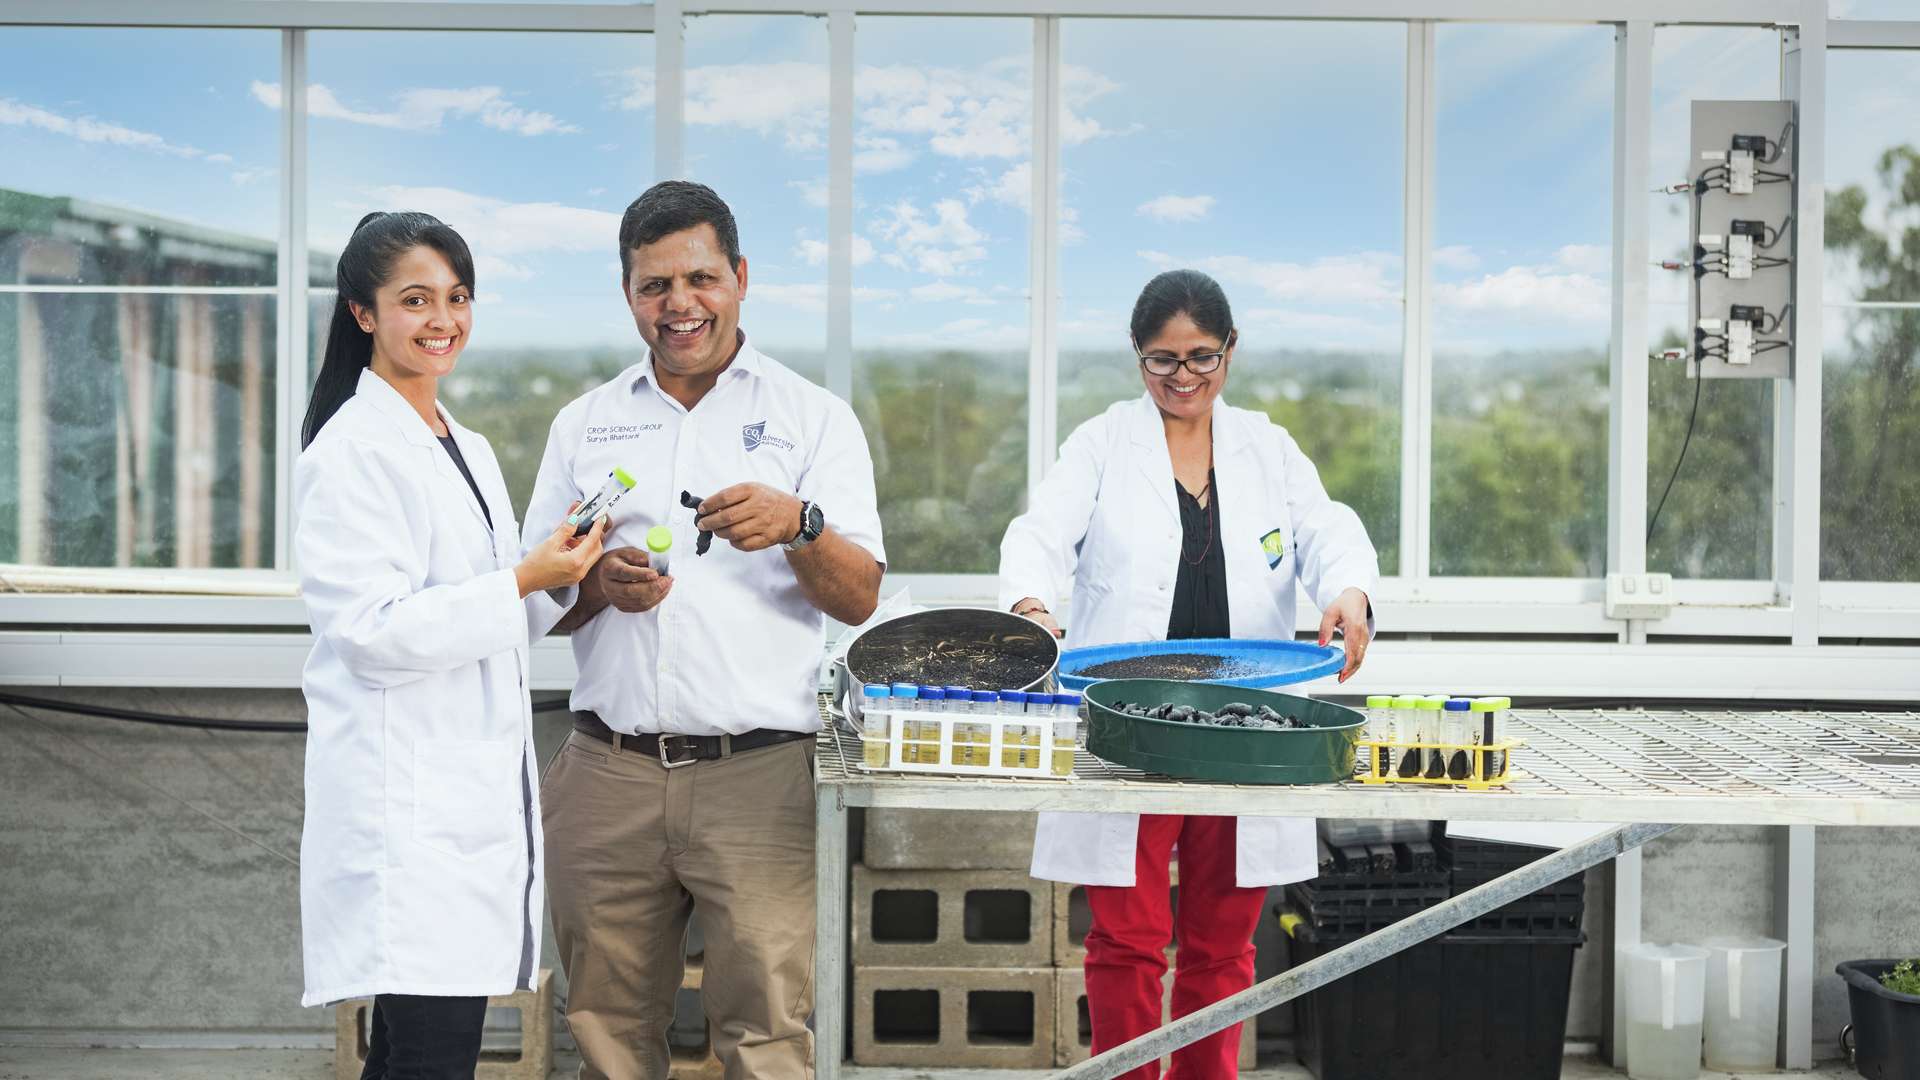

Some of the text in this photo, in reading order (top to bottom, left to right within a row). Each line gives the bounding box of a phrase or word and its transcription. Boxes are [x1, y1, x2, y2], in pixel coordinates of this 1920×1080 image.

[586, 423, 663, 435] CROP SCIENCE GROUP
[586, 435, 608, 444] Surya
